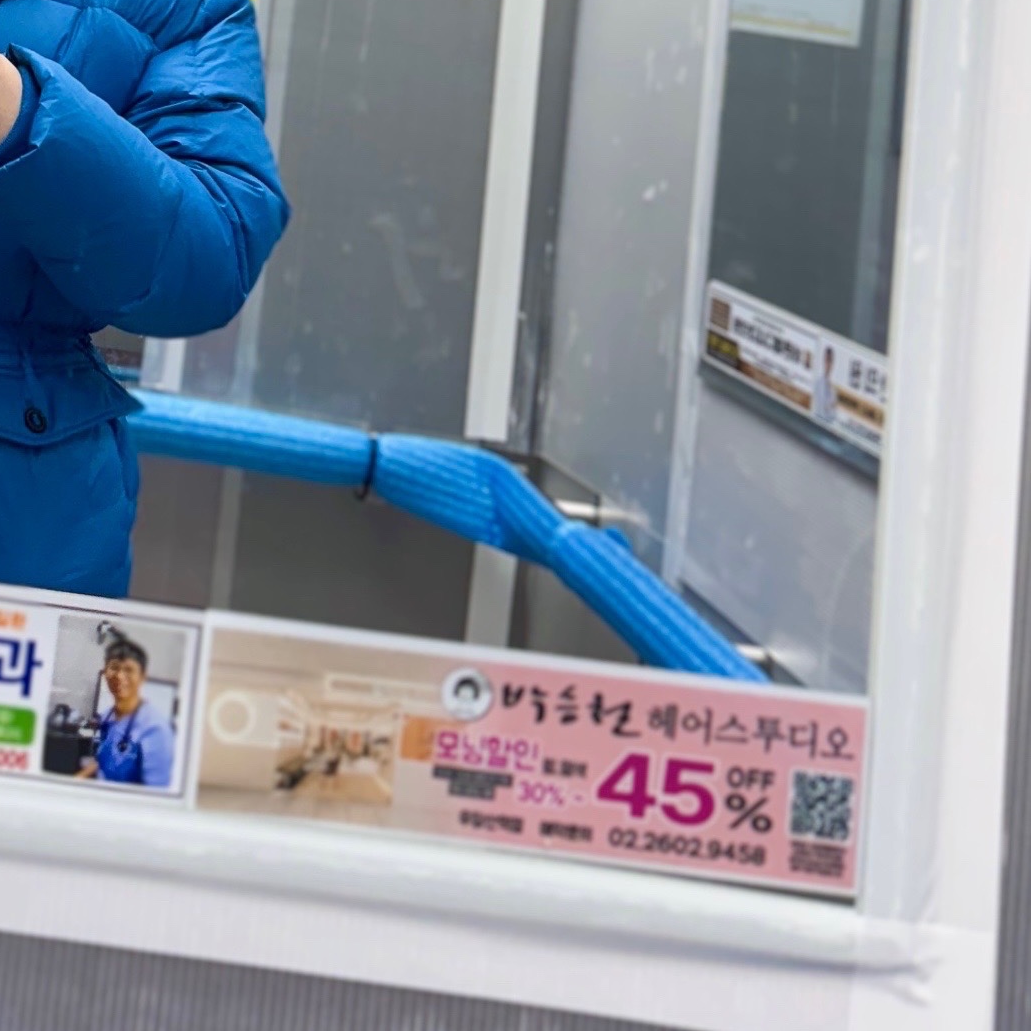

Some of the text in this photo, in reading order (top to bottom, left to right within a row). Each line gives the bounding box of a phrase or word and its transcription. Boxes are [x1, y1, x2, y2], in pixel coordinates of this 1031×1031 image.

[436, 730, 540, 772] 모닝할인
[648, 704, 855, 762] 헤어스투디오
[597, 753, 715, 826] 45
[725, 794, 774, 834] %
[727, 767, 775, 790] OFF
